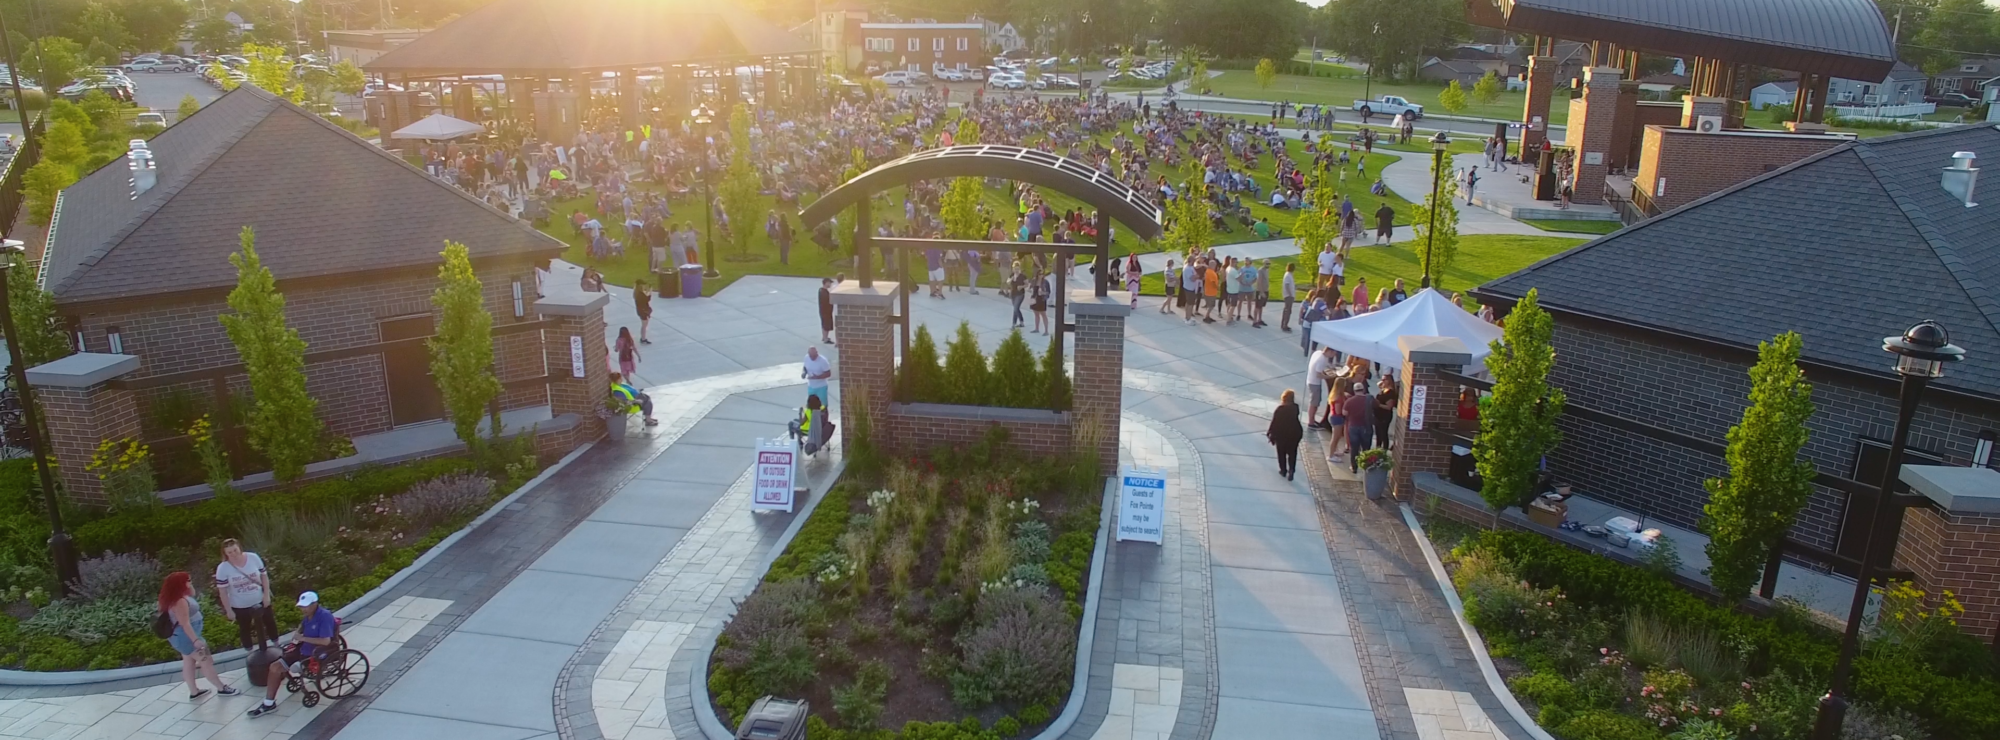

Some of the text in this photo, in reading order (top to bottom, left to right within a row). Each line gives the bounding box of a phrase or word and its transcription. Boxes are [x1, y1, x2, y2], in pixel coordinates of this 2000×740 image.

[760, 453, 789, 463] ATTENTION
[769, 467, 785, 476] OUTSIDE
[759, 479, 769, 488] FOOD
[1128, 478, 1160, 487] NOTICE
[763, 492, 781, 500] ALLOWED
[1132, 489, 1148, 497] Guests
[1130, 501, 1154, 510] Fox Pointe
[1132, 514, 1142, 523] may
[1121, 525, 1138, 534] subject
[1144, 527, 1158, 535] search
